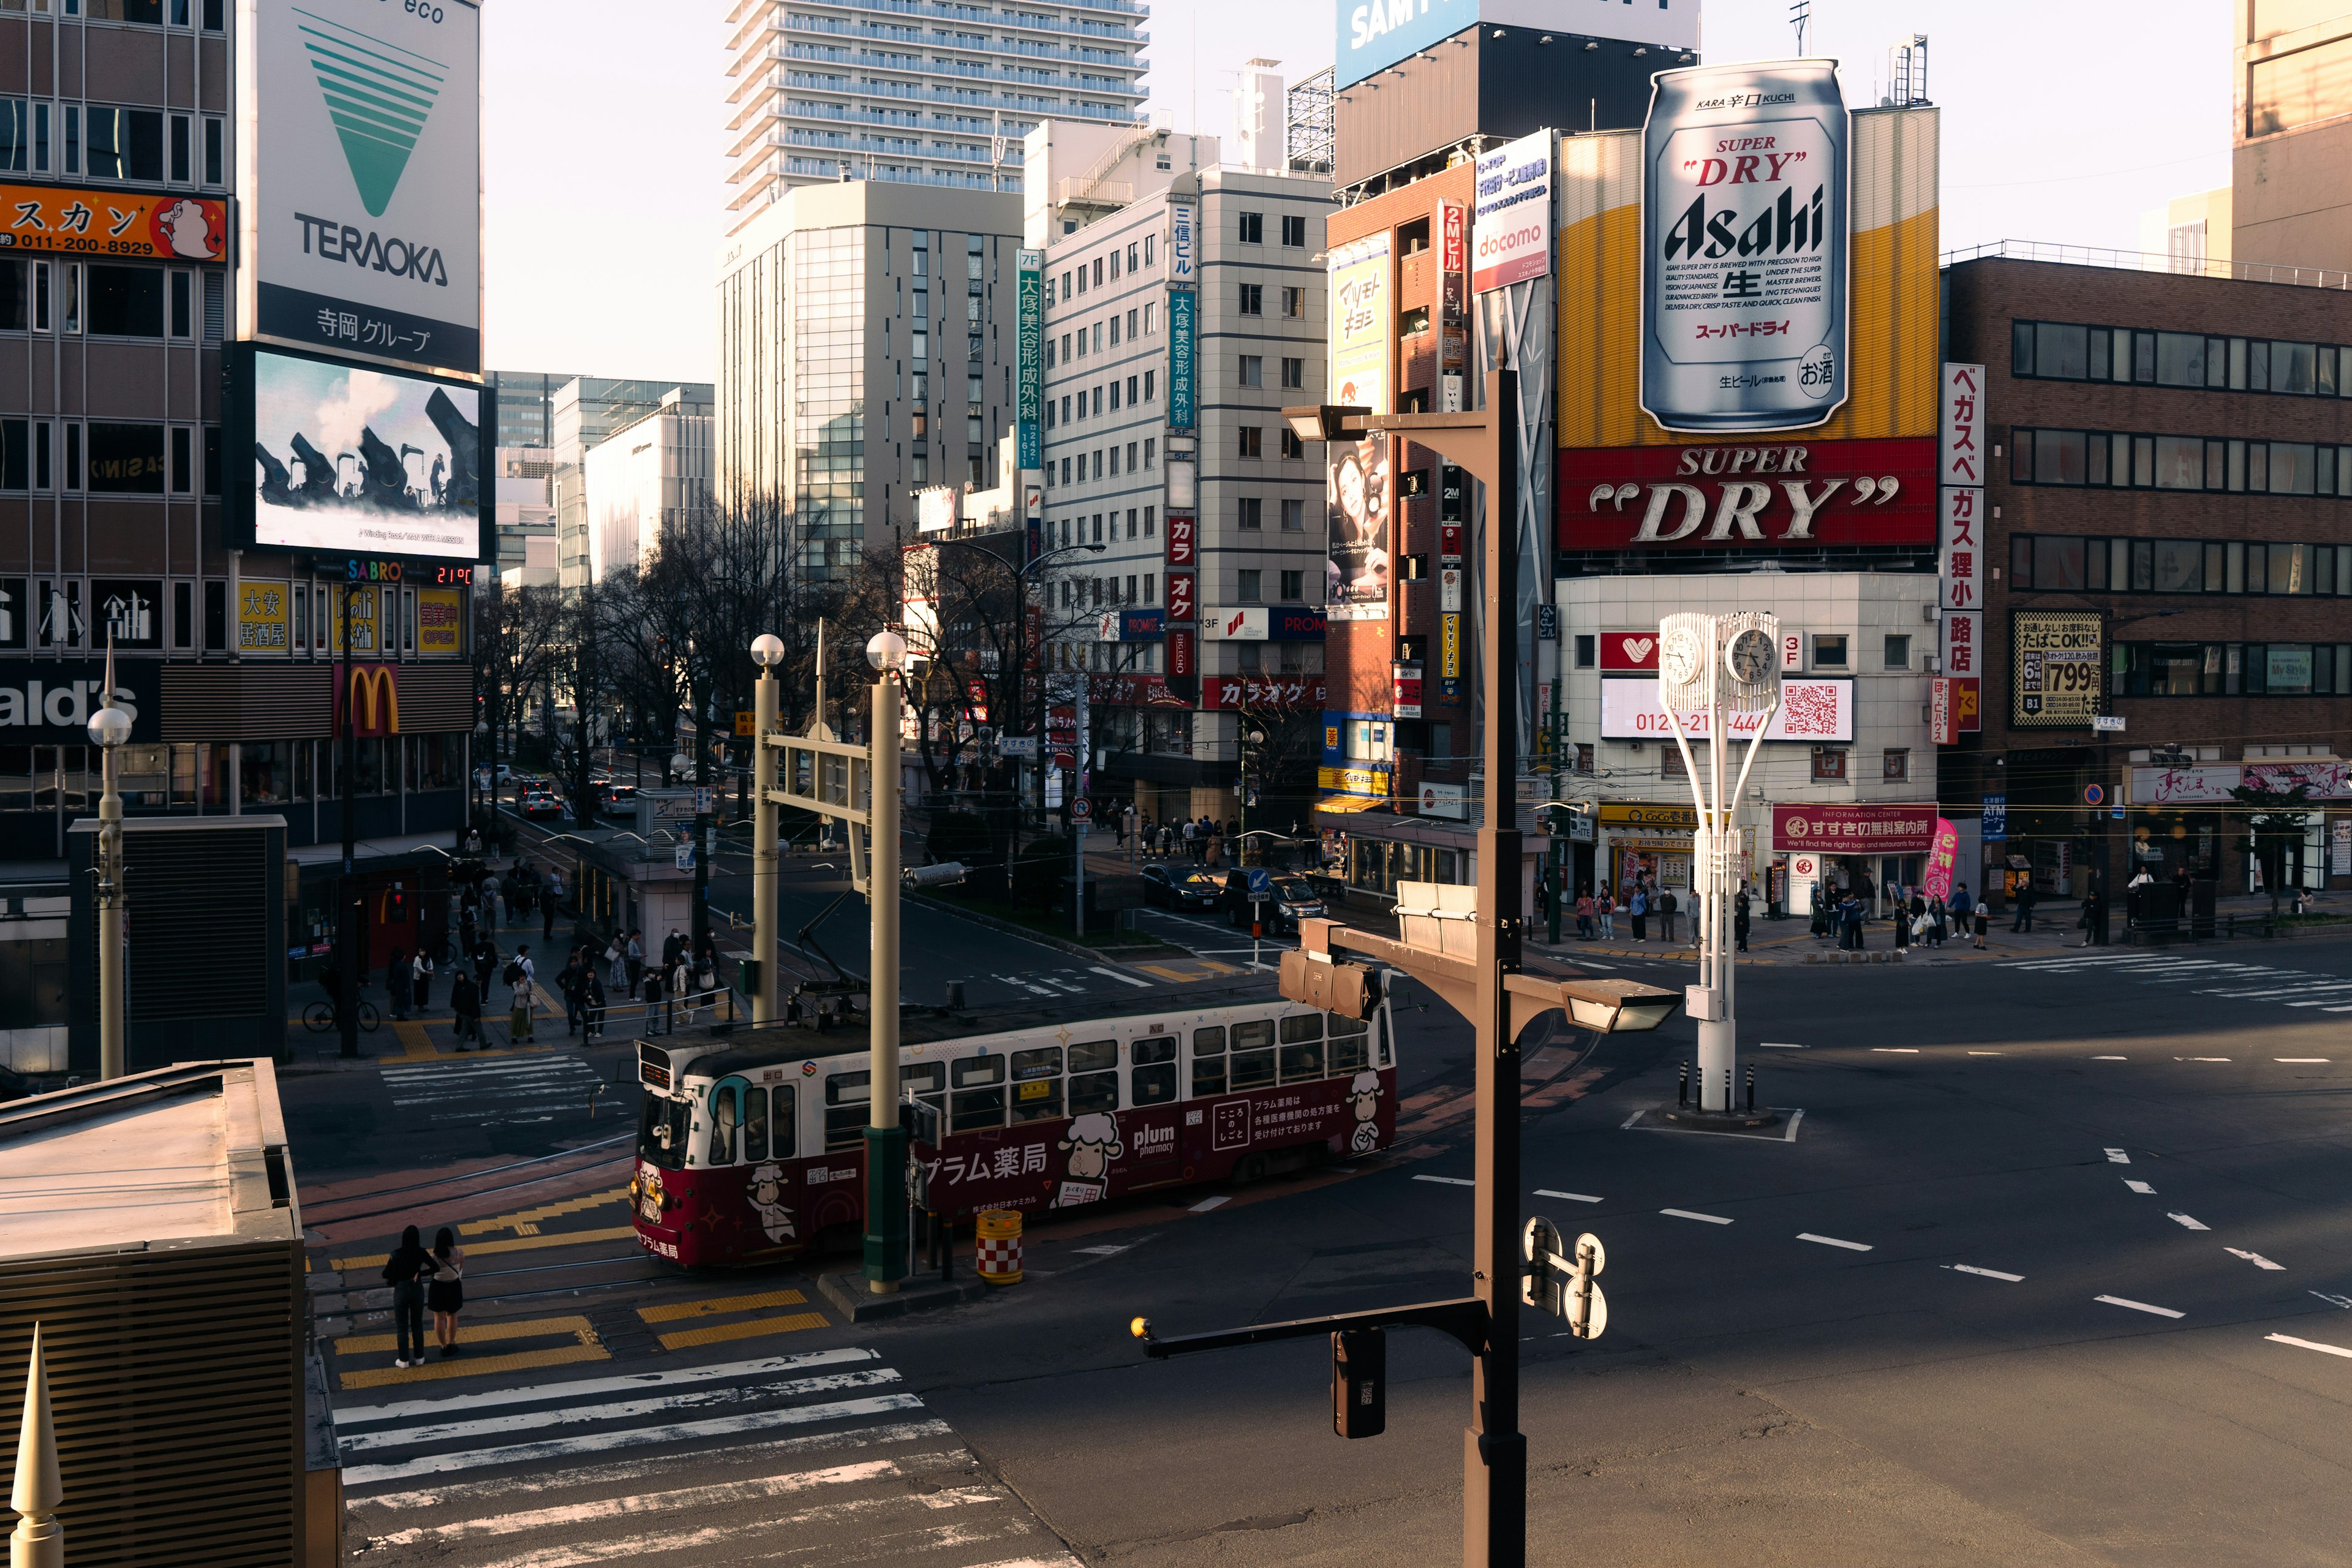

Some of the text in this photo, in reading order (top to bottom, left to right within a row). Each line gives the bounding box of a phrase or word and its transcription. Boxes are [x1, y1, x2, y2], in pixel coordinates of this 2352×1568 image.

[404, 0, 443, 23] eco
[1697, 93, 1795, 108] KARA 辛口 KUCHI
[1716, 137, 1776, 153] SUPER
[1477, 157, 1547, 198] 千代田サービス販売(株)
[0, 194, 137, 237] スカン
[1664, 184, 1823, 261] Asahi
[21, 234, 153, 255] 011-200-8929
[1174, 208, 1191, 275] 三信ビル
[1446, 208, 1461, 270] 2Mビル
[1480, 225, 1541, 257] docomo
[294, 212, 448, 287] TERAOKA
[1021, 255, 1038, 266] 7F
[1522, 257, 1546, 270] ドコモショップ
[1340, 273, 1380, 309] マツモト
[1722, 270, 1762, 298] 生
[1780, 285, 1822, 295] TECHNIQUES
[317, 308, 431, 352] 寺岡グループ
[1344, 308, 1374, 339] キヨシ
[1695, 320, 1790, 339] スーパードライ
[1020, 277, 1039, 420] 大塚美容形成外科
[1175, 296, 1190, 424] 大塚美容形成外科
[1801, 360, 1833, 385] お酒
[1676, 446, 1807, 476] SUPER
[1444, 488, 1459, 499] 2M
[364, 529, 387, 540] Winding
[349, 559, 402, 581] SABRO
[244, 590, 280, 616] 大安
[420, 602, 458, 627] 営業中
[1205, 619, 1218, 628] 3F
[239, 622, 285, 647] 居酒屋
[423, 630, 455, 644] OPEN
[1539, 628, 1555, 638] ビル
[2023, 633, 2089, 648] たばこOK!!
[1445, 613, 1456, 676] マツモトキヨシ
[2051, 662, 2091, 692] 799
[2271, 664, 2307, 676] My Style
[1220, 683, 1306, 703] カラオケ
[1934, 681, 1944, 741] ほっとハウス
[2027, 698, 2038, 709] B1
[1001, 739, 1035, 748] すすきの
[1327, 728, 1336, 745] 薬
[1983, 805, 2005, 816] ATM
[1811, 820, 1928, 836] すすきの無料案内所
[1834, 840, 1850, 850] right
[1149, 1024, 1164, 1033] 入口
[764, 1070, 782, 1080] 出口
[1255, 1095, 1301, 1111] プラム薬局は
[1219, 1109, 1244, 1120] こころ
[1254, 1104, 1340, 1126] 各種医療機関の処方箋を
[1134, 1123, 1175, 1150] plum
[1220, 1129, 1243, 1142] しごと
[1254, 1121, 1322, 1140] 受け付けております
[1139, 1141, 1174, 1158] pharmacy
[809, 1169, 826, 1178] ワンマン
[925, 1142, 1047, 1186] プラム薬局
[809, 1175, 826, 1183] 出口
[972, 1196, 1037, 1214] 株式会社日本ケミカル
[641, 1232, 678, 1259] プラム薬局
